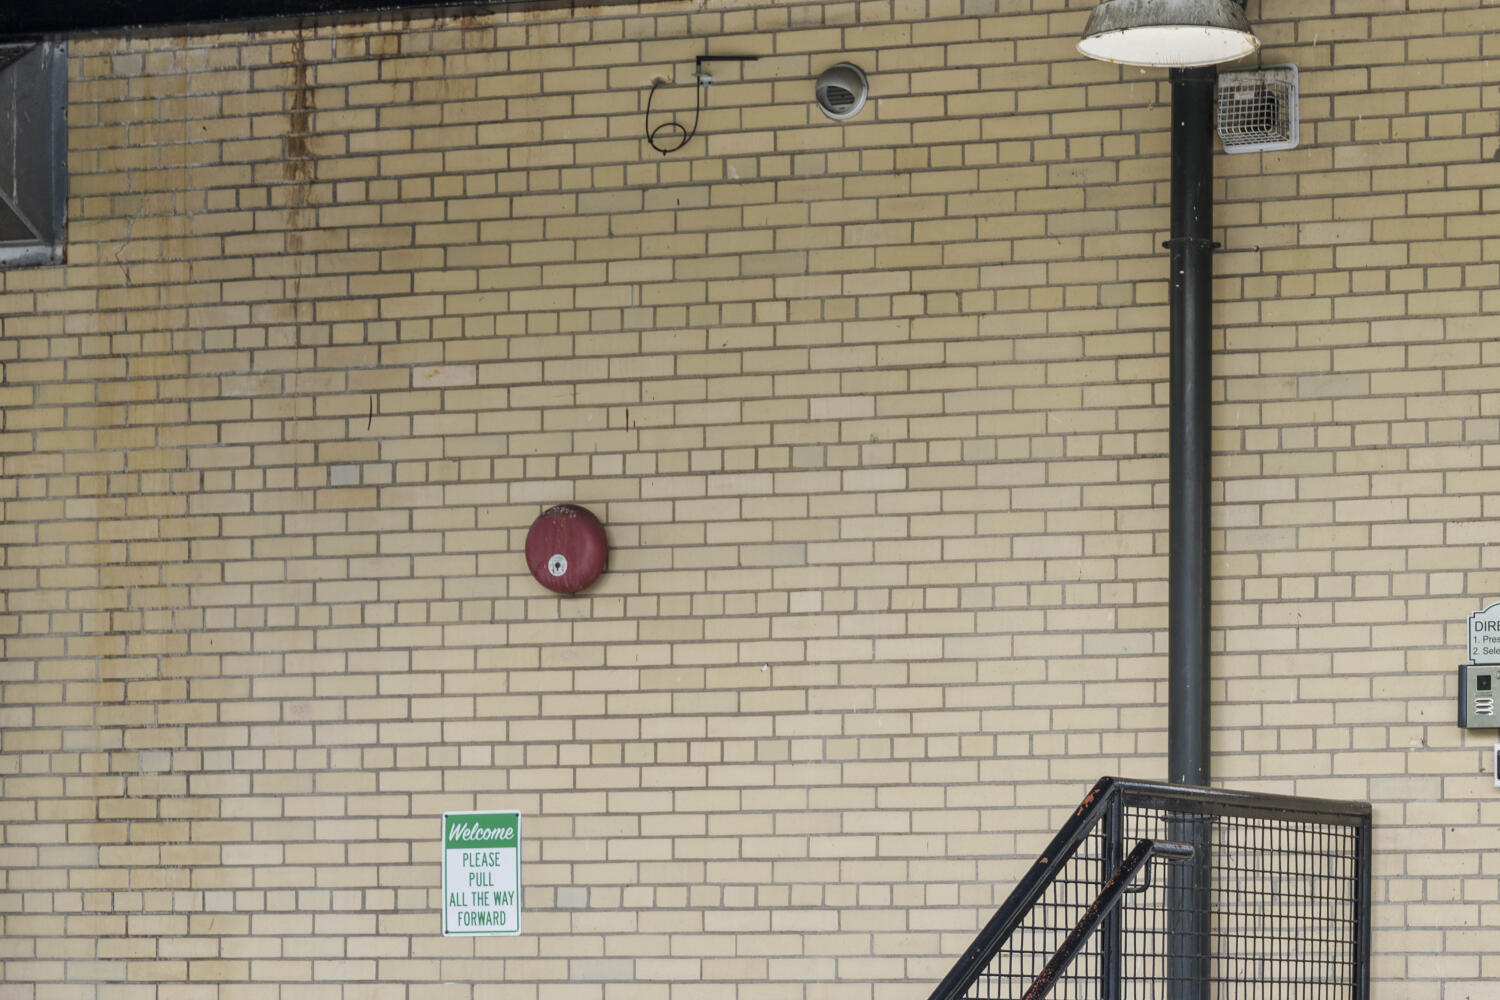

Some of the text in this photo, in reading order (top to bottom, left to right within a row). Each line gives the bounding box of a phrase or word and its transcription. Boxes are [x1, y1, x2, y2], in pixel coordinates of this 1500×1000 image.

[1473, 635, 1480, 644] 1.
[1472, 647, 1480, 655] 2.
[449, 822, 514, 841] Welcome
[463, 852, 501, 867] PLEASE
[469, 871, 494, 887] PULL
[449, 890, 514, 907] ALL THE WAY
[457, 911, 506, 927] FORWARD
